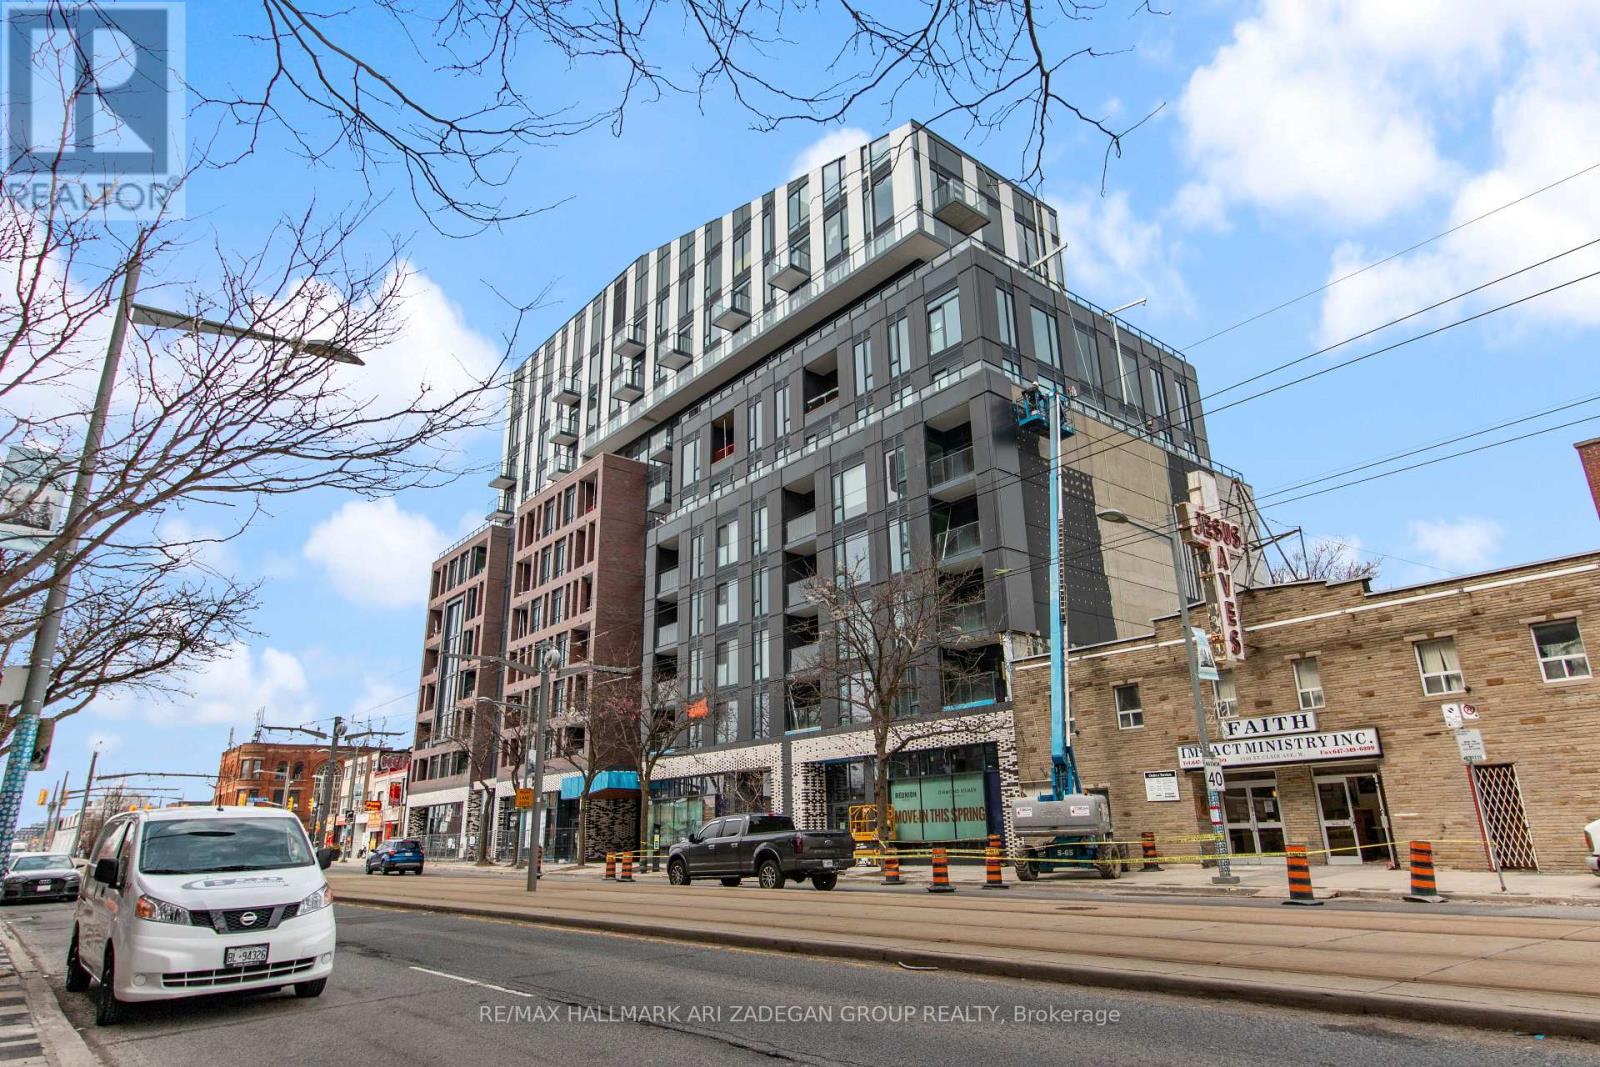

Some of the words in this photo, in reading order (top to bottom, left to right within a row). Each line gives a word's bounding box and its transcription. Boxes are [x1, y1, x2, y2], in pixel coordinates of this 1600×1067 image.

[1194, 511, 1241, 548] JESUS
[1227, 714, 1309, 736] FAITH
[1181, 743, 1242, 759] IMACT
[1244, 735, 1328, 754] MINISTRY
[1333, 732, 1374, 747] INC.
[1208, 772, 1223, 787] 40
[929, 808, 950, 823] THIS
[951, 806, 986, 822] SPRING
